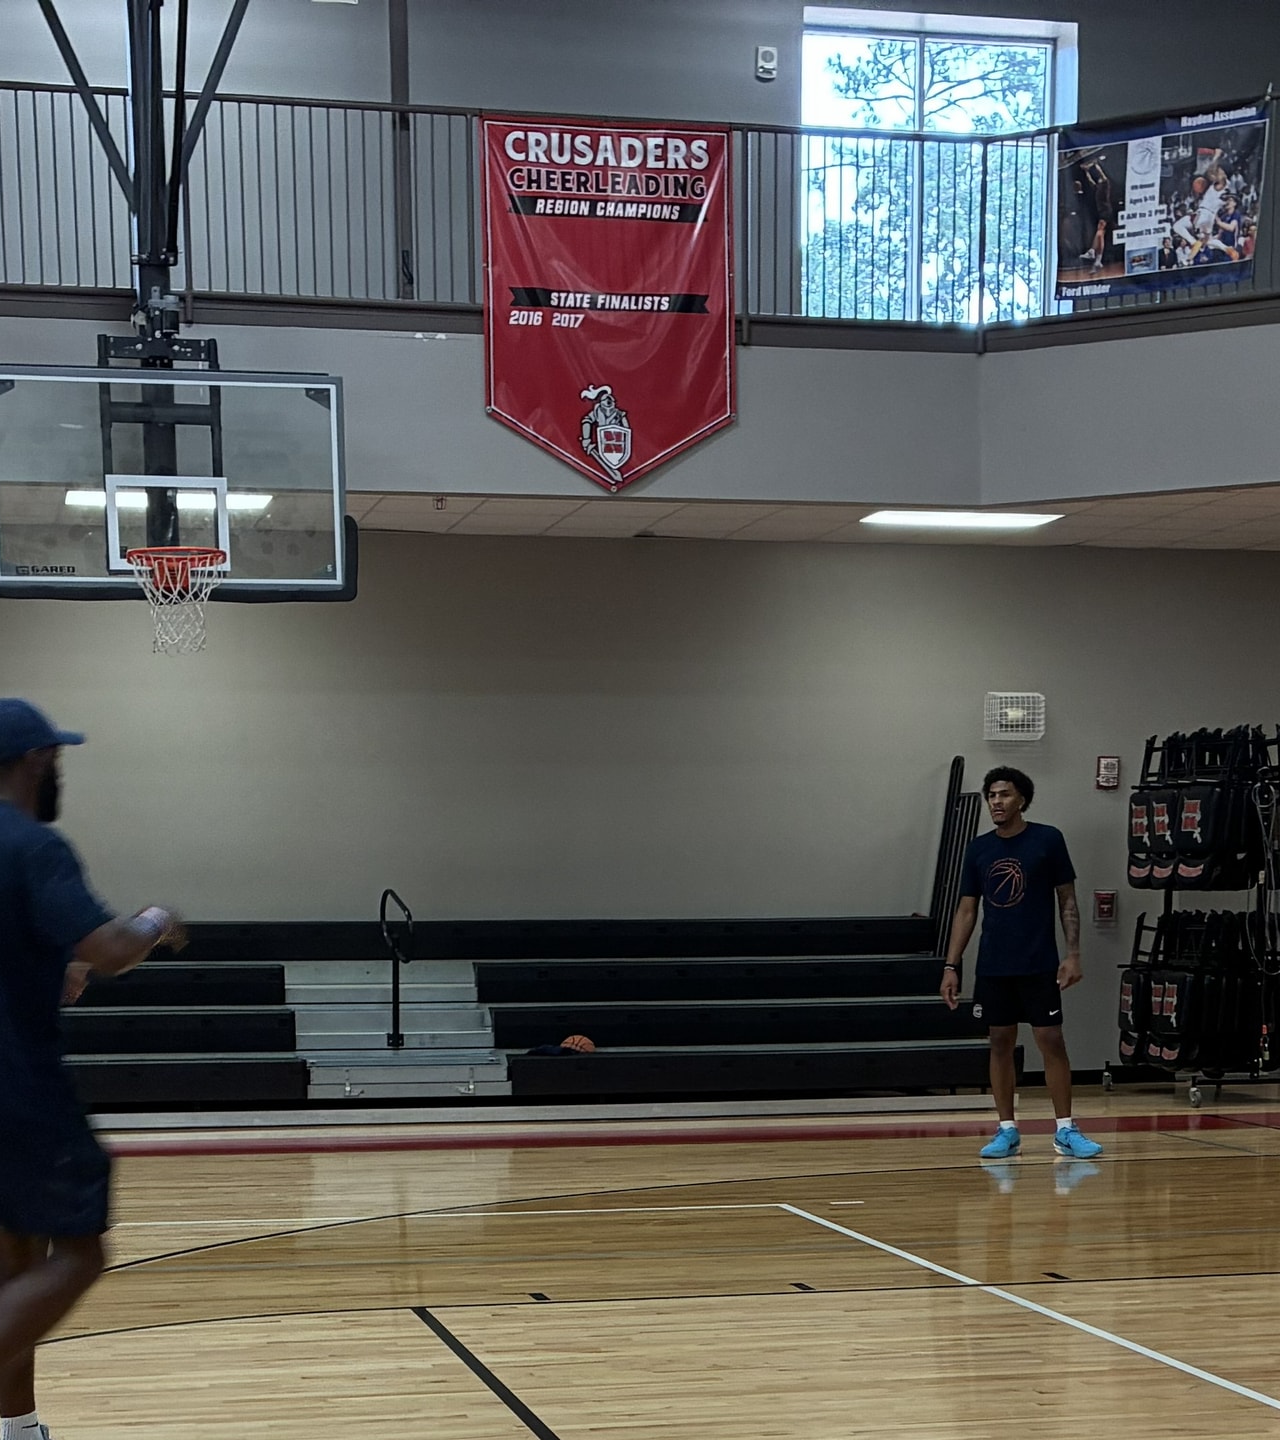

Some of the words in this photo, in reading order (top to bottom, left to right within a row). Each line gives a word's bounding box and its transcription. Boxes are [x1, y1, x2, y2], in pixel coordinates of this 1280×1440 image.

[505, 131, 709, 170] CRUSADERS
[509, 166, 706, 198] CHEERLEADING
[535, 199, 589, 215] REGION
[596, 202, 680, 219] CHAMPIONS
[550, 292, 590, 308] STATE
[597, 295, 670, 311] FINALISTS
[509, 311, 542, 326] 2016
[552, 313, 584, 328] 2017
